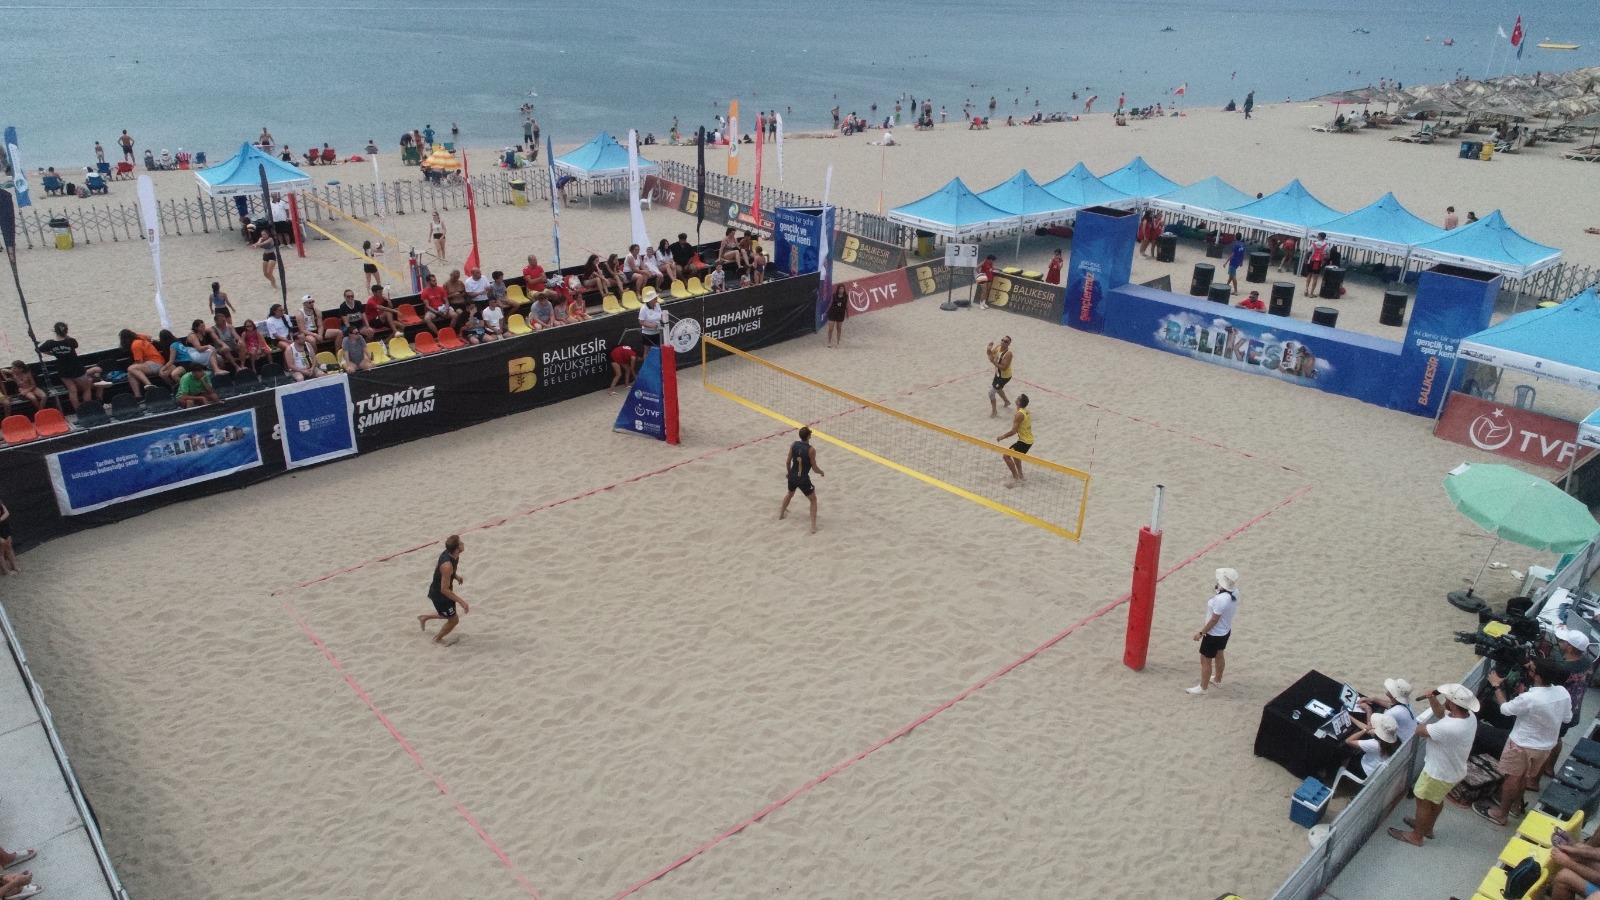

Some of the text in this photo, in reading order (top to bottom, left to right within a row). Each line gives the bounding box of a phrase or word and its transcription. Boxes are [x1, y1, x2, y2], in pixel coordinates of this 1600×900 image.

[782, 213, 795, 222] deniz
[784, 232, 811, 246] spor kenti
[800, 227, 807, 236] ve
[953, 245, 978, 257] 3 3
[869, 282, 898, 303] TVF
[1013, 284, 1055, 301] BALIKESİR
[705, 305, 764, 328] BURHANİYE
[542, 337, 607, 365] BALIKESİR
[1417, 339, 1443, 349] gençlik
[1421, 347, 1438, 355] spor
[1439, 349, 1456, 359] kent
[543, 352, 607, 378] BÜYÜKŞEHİR
[543, 364, 609, 387] BELEDİYESİ
[1418, 356, 1438, 405] BALIKESİR
[356, 385, 436, 414] TÜRKİYE
[357, 398, 436, 433] ŞAMPİYONASI
[645, 408, 660, 418] TVF
[1519, 429, 1582, 463] TVF
[1345, 689, 1354, 702] 2
